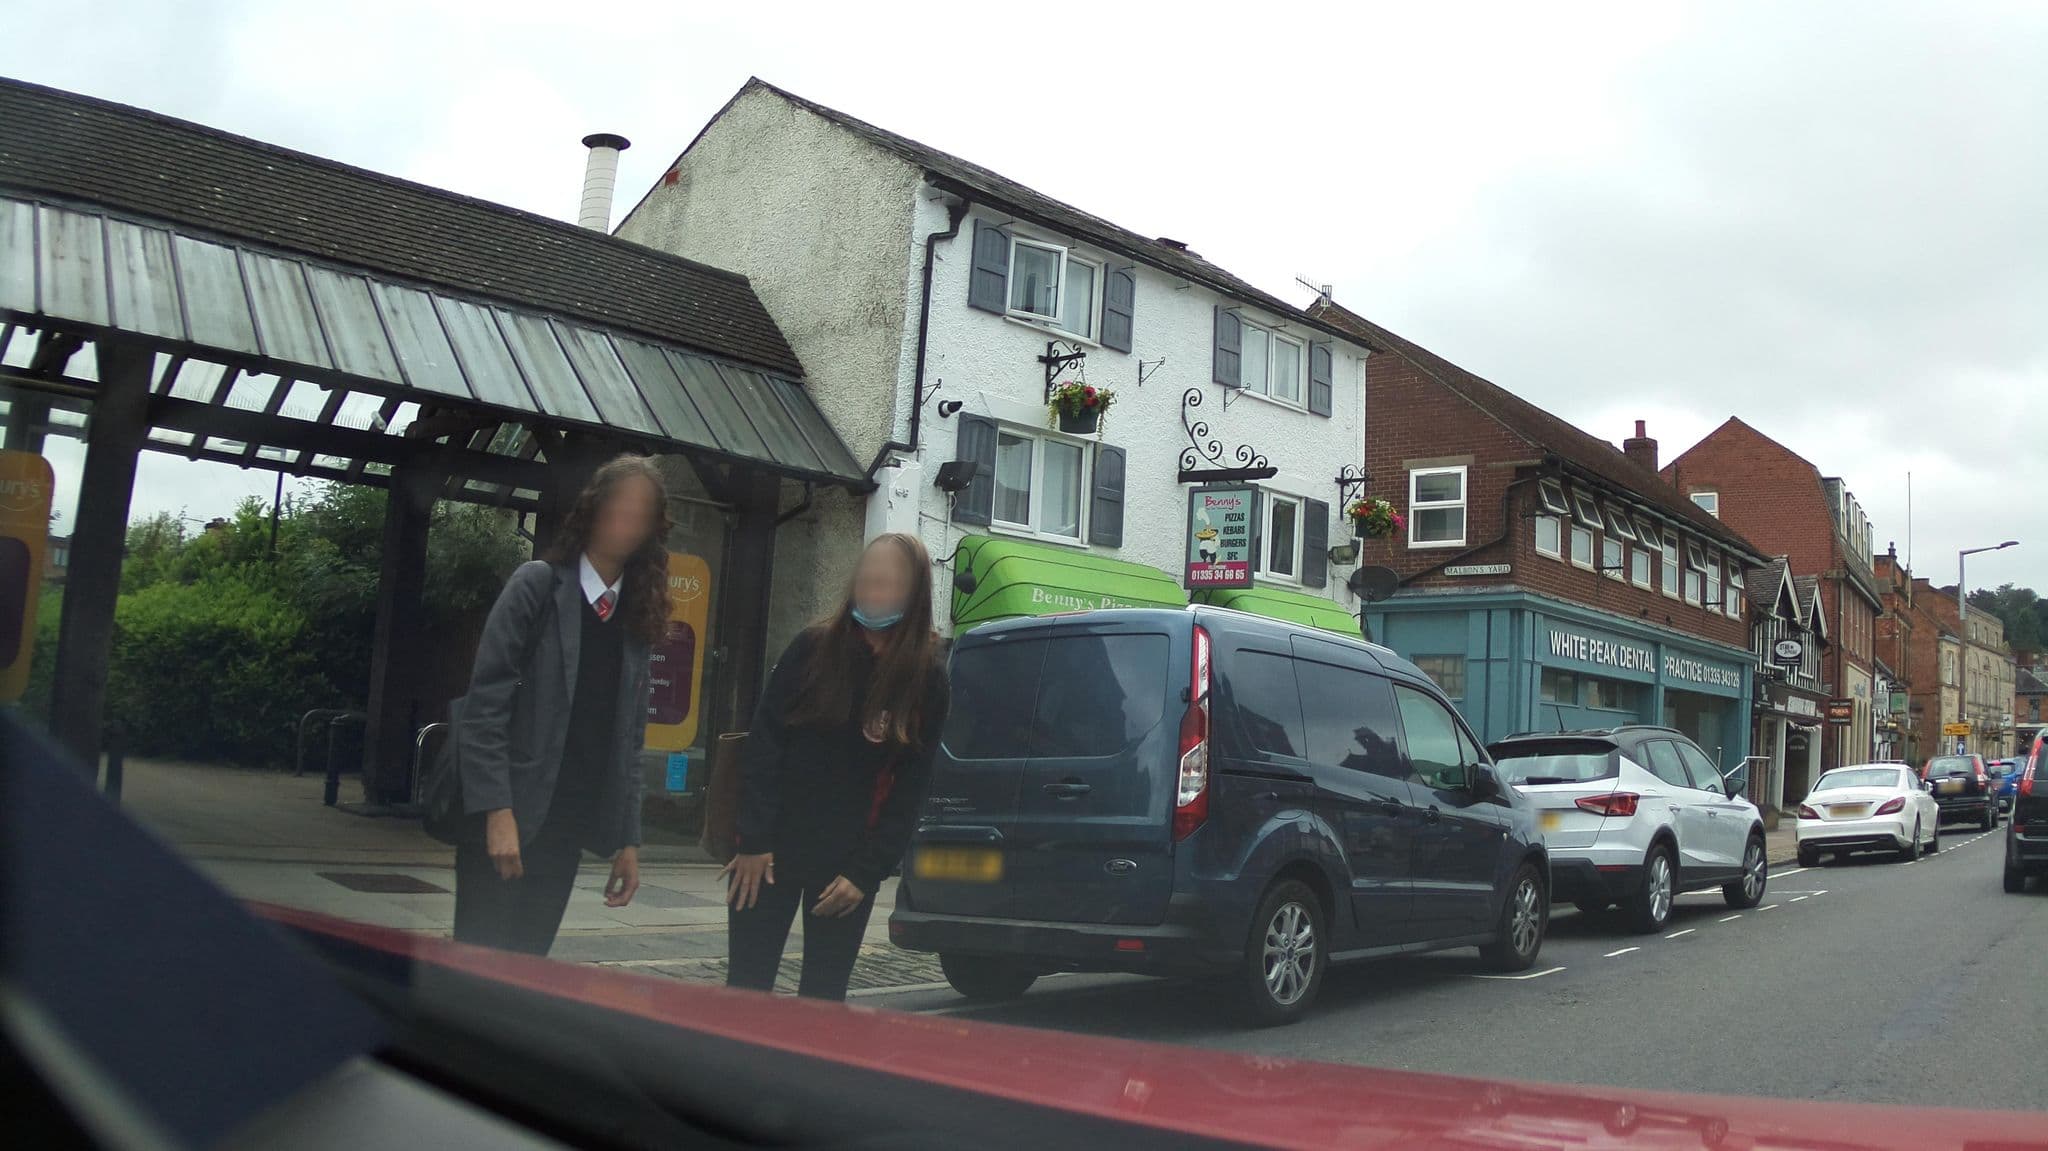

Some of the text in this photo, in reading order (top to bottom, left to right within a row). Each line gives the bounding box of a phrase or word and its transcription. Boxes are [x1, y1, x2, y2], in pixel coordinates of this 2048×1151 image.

[1205, 494, 1242, 510] Benny's
[1224, 512, 1245, 522] PIZZAS
[1222, 525, 1246, 535] KEBABS
[1220, 538, 1247, 548] BURGERS
[1488, 564, 1509, 573] YARD
[670, 575, 700, 592] ury's
[1031, 587, 1095, 611] Benny's
[1550, 630, 1656, 673] WHITE PEAK DENTAL
[1664, 655, 1702, 682] PRACTICE
